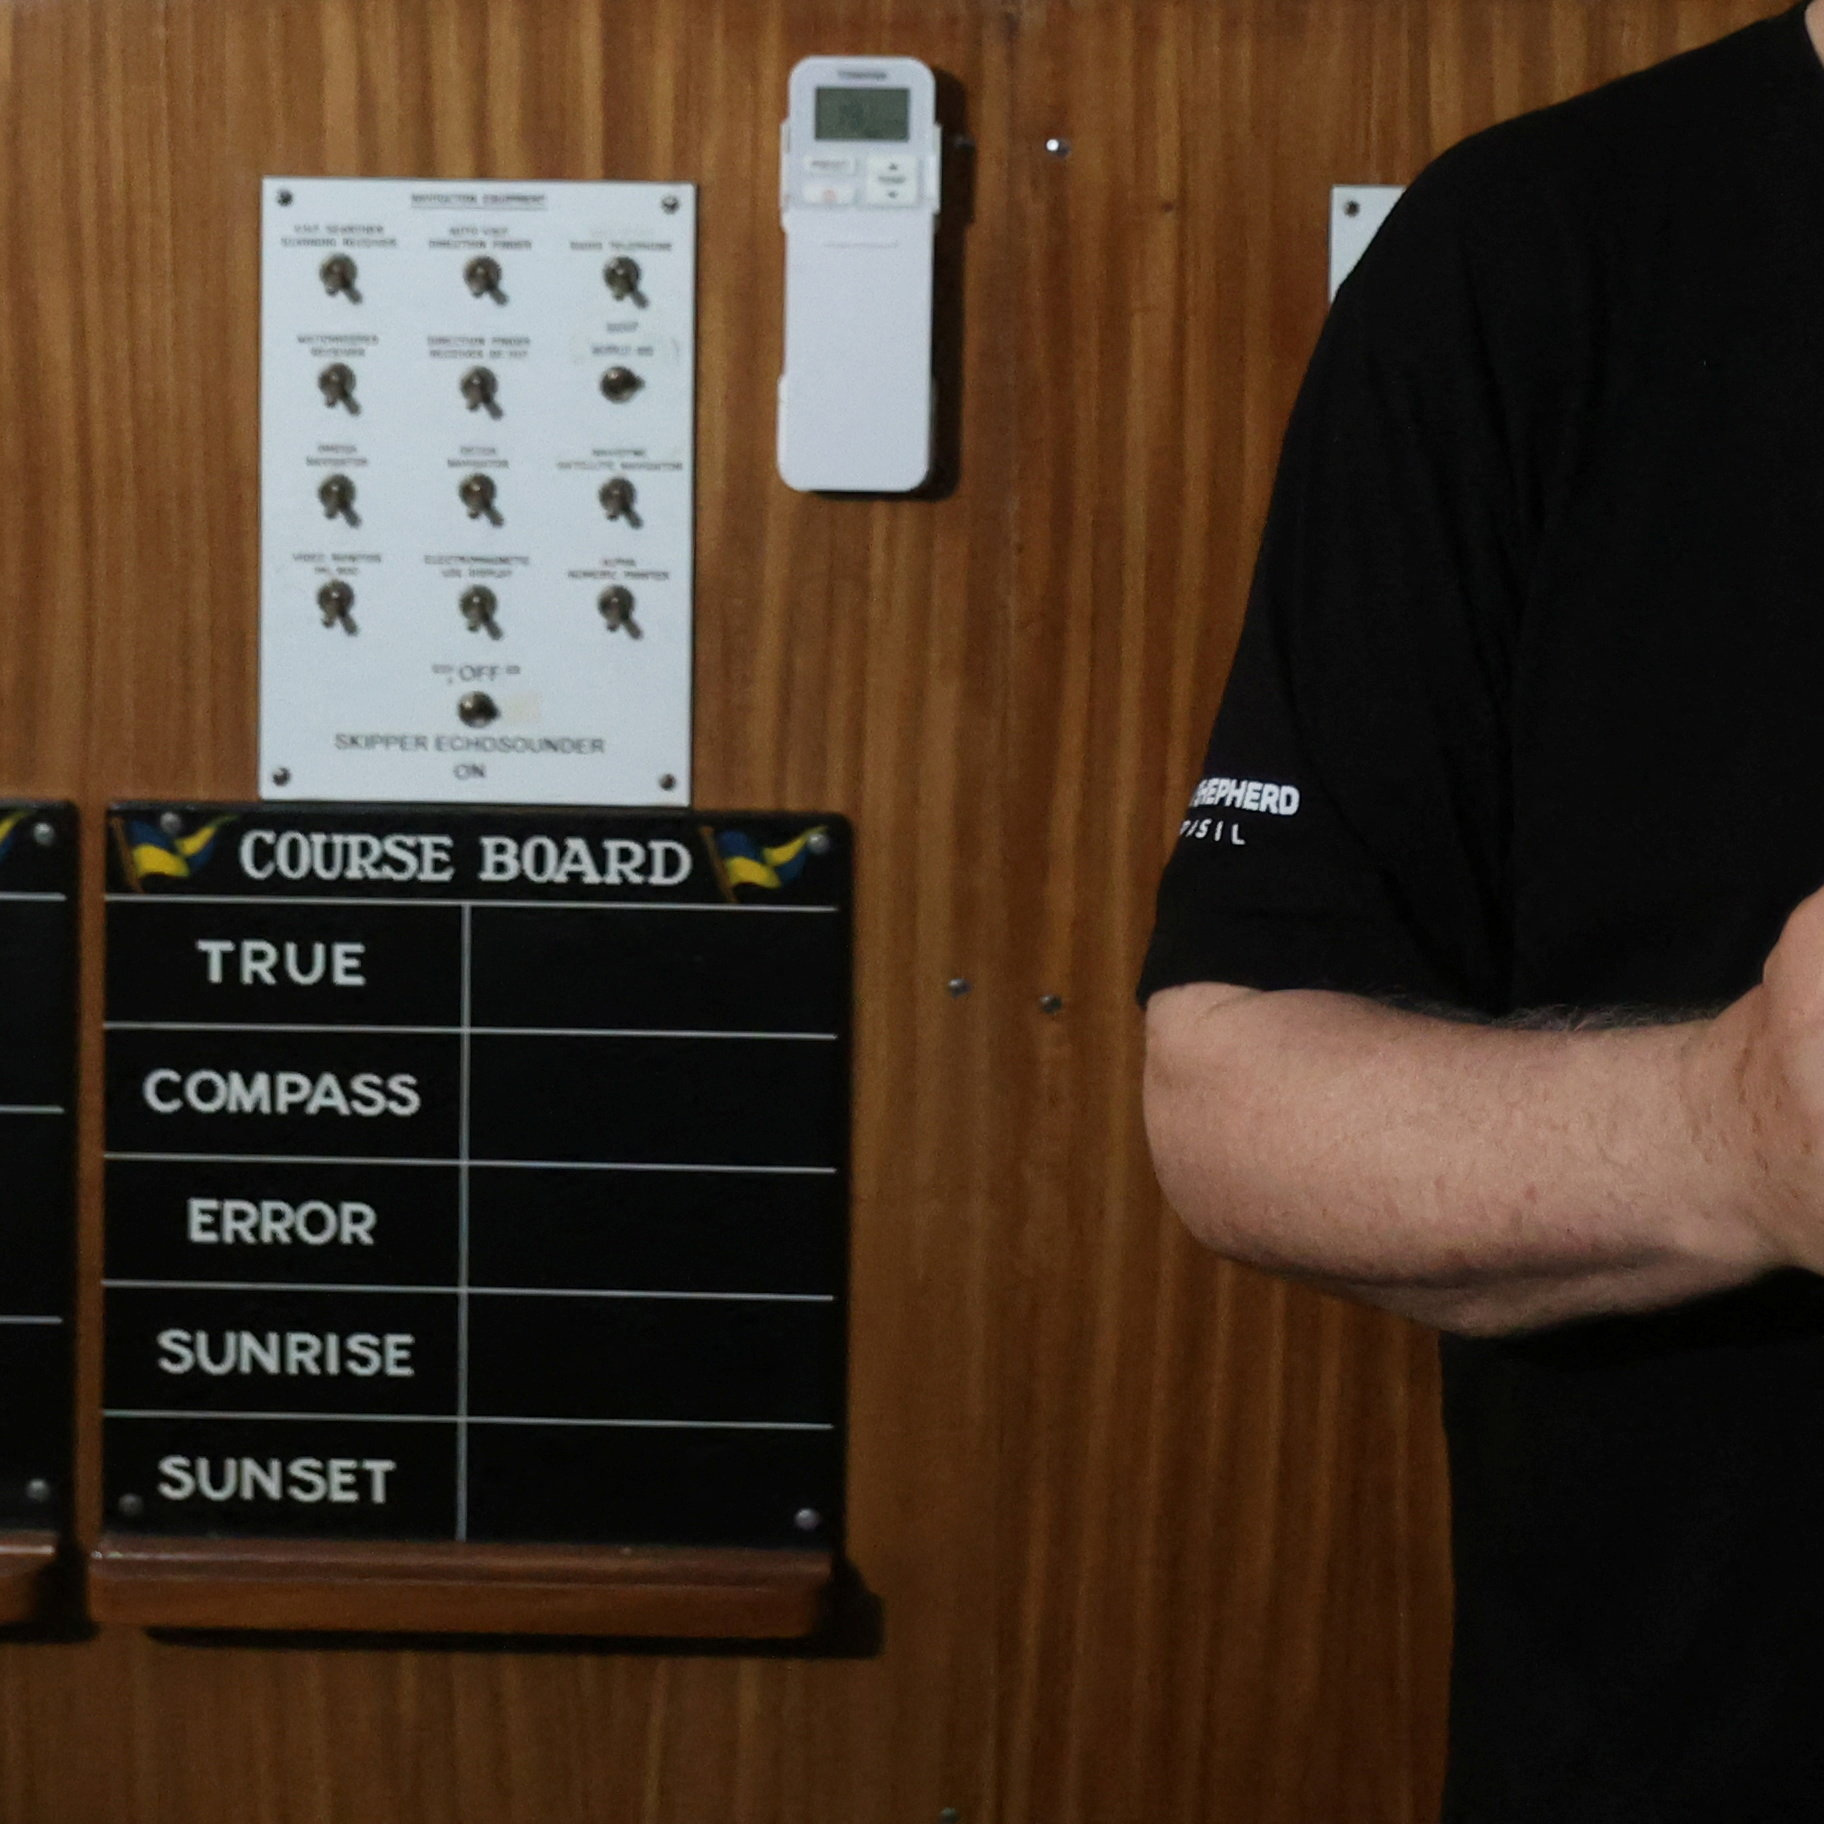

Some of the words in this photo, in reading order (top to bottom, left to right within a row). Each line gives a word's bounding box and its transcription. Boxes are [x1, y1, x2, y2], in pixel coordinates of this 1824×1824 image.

[458, 664, 499, 682] OFF
[334, 733, 429, 752] SKIPPER
[434, 734, 606, 755] ECHOSOUNDER
[452, 763, 486, 780] ON
[239, 829, 455, 882] COURSE
[479, 835, 692, 886] BOARD
[196, 939, 366, 987] TRUE
[143, 1068, 422, 1117] COMPASS
[187, 1197, 377, 1246] ERROR
[157, 1328, 415, 1378] SUNRISE
[158, 1454, 397, 1505] SUNSET
